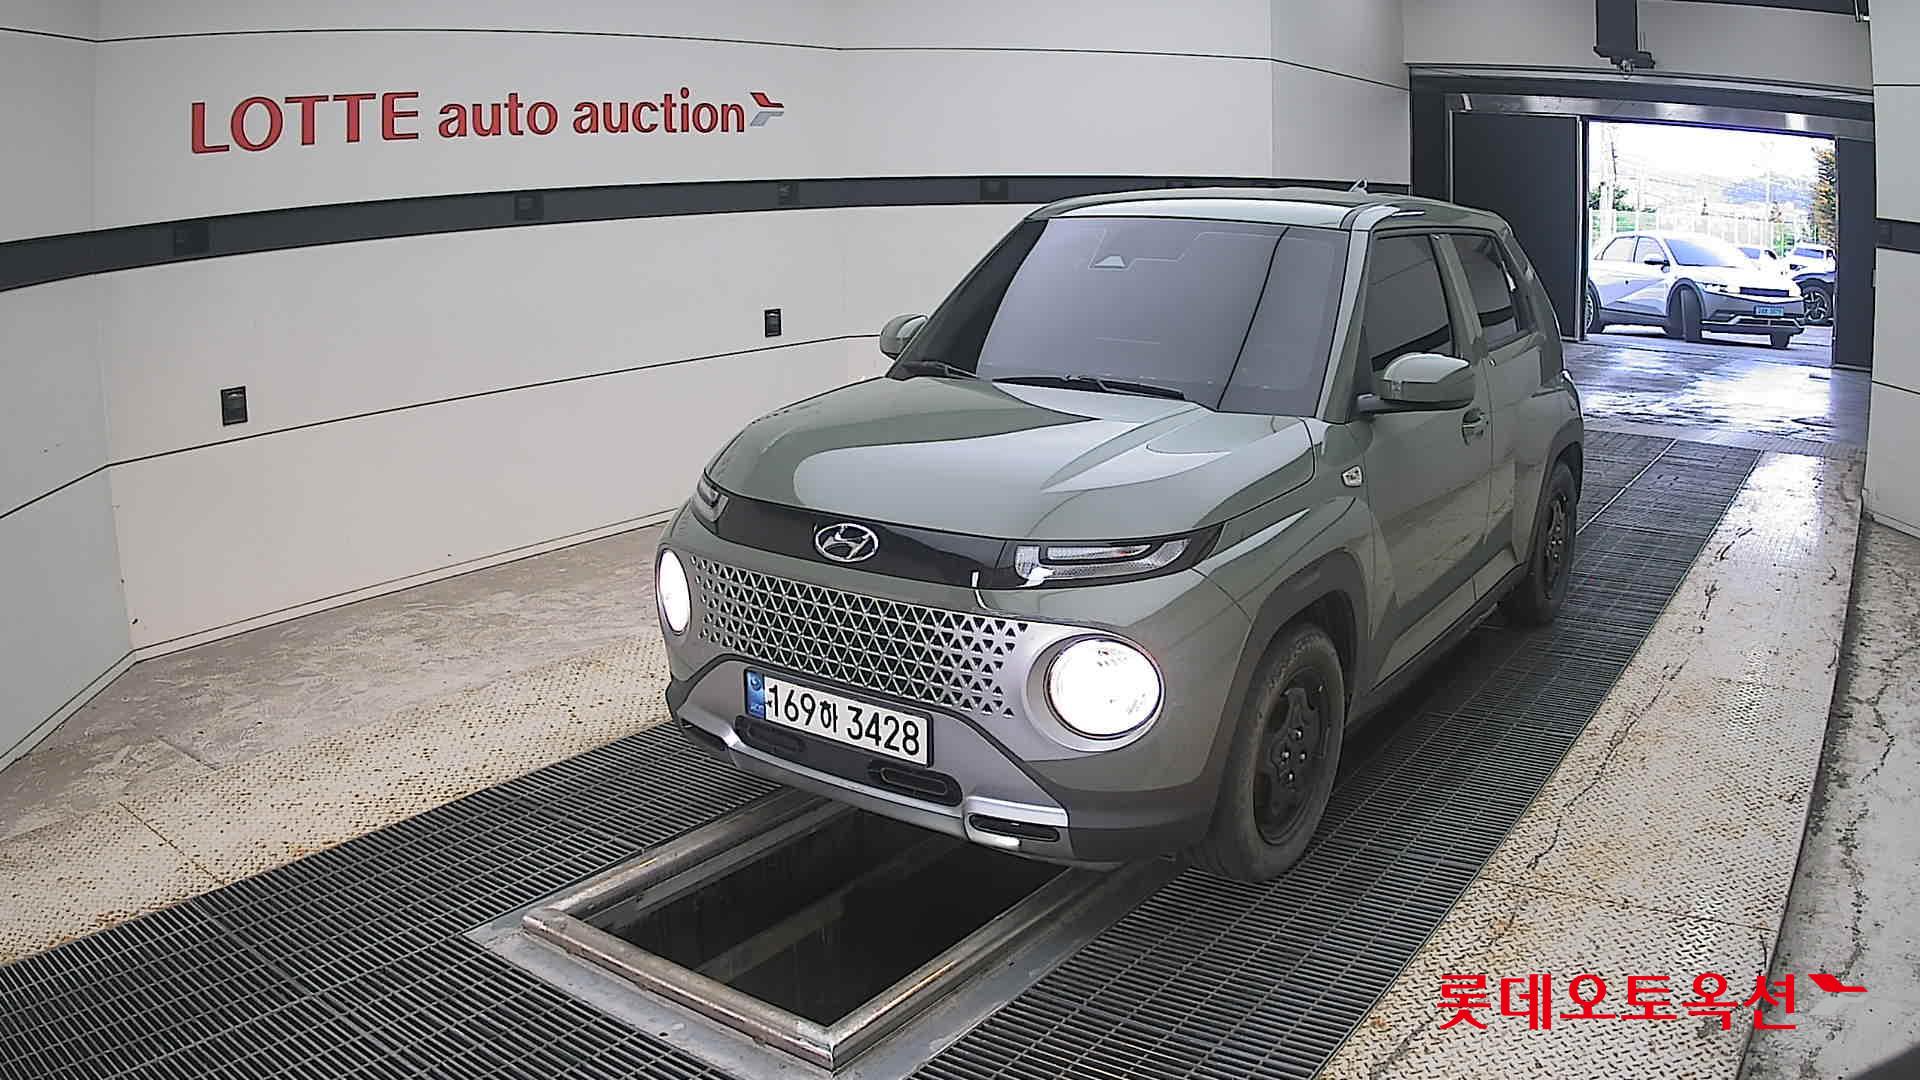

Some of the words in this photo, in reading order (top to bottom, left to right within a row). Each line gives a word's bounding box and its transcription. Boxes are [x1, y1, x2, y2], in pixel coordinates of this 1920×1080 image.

[191, 91, 419, 154] LOTTE
[438, 93, 558, 138] auto
[573, 87, 745, 134] auction
[768, 684, 839, 733] 169하
[847, 705, 920, 756] 3428
